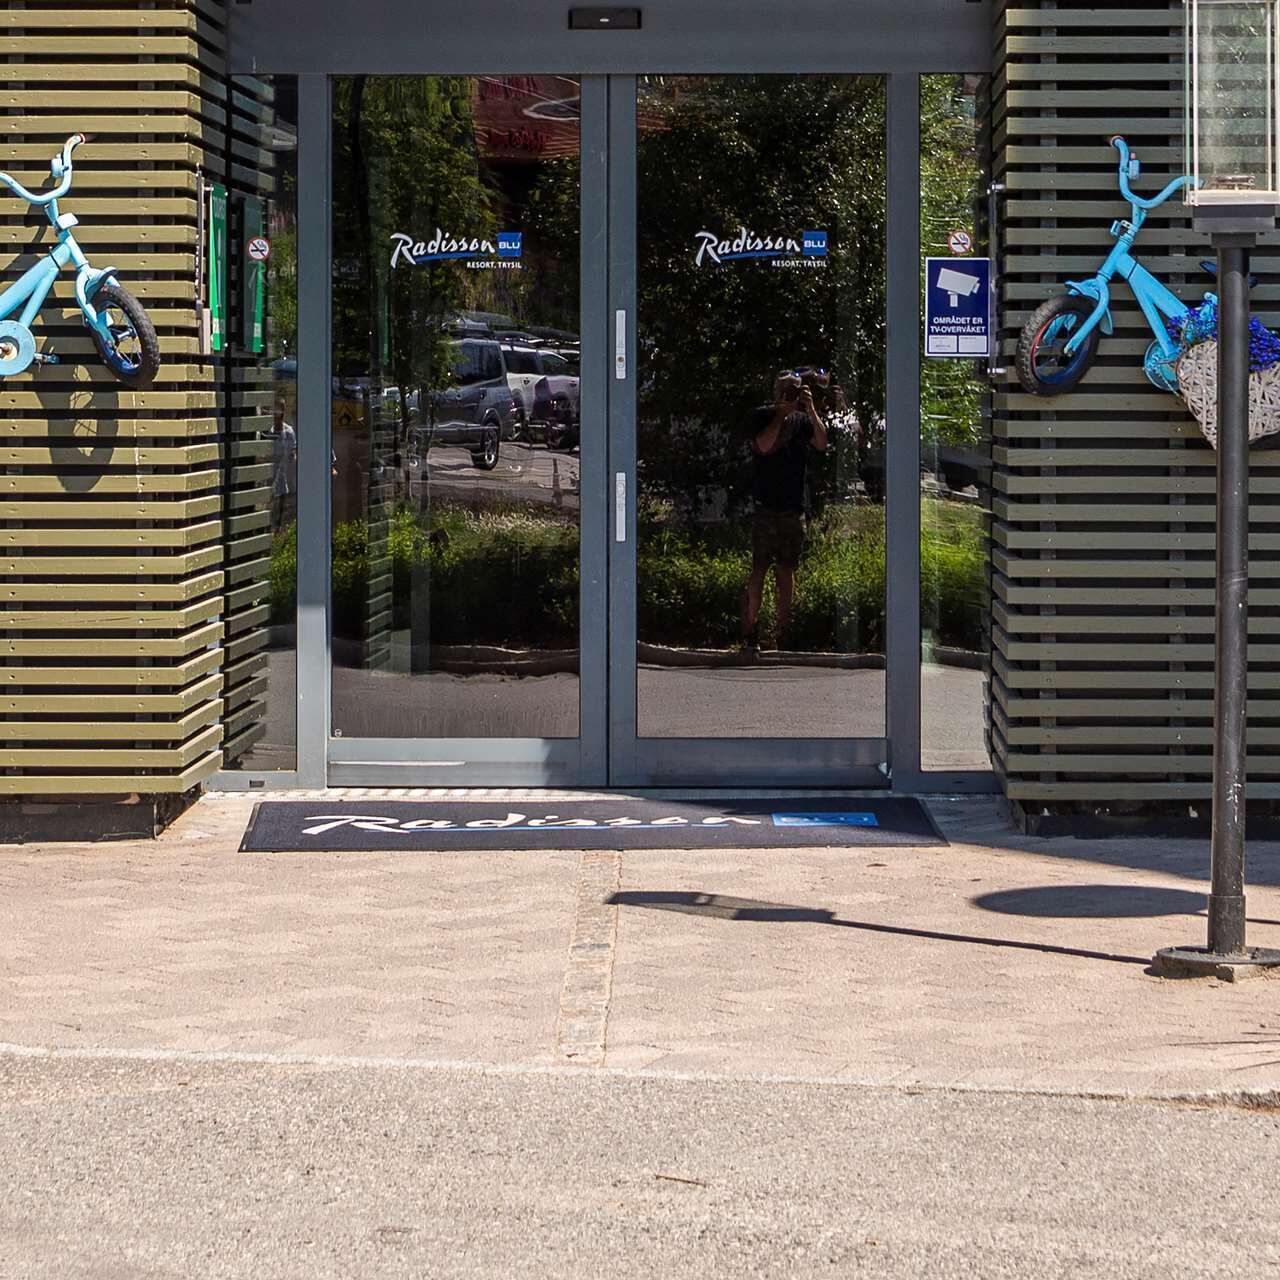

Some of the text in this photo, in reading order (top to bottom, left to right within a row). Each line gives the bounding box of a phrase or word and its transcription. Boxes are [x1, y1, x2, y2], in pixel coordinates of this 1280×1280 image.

[390, 227, 521, 269] Radisson BLU
[694, 225, 826, 267] Radisson BLU
[933, 316, 971, 324] OMRÅDET
[302, 812, 761, 835] Radisson
